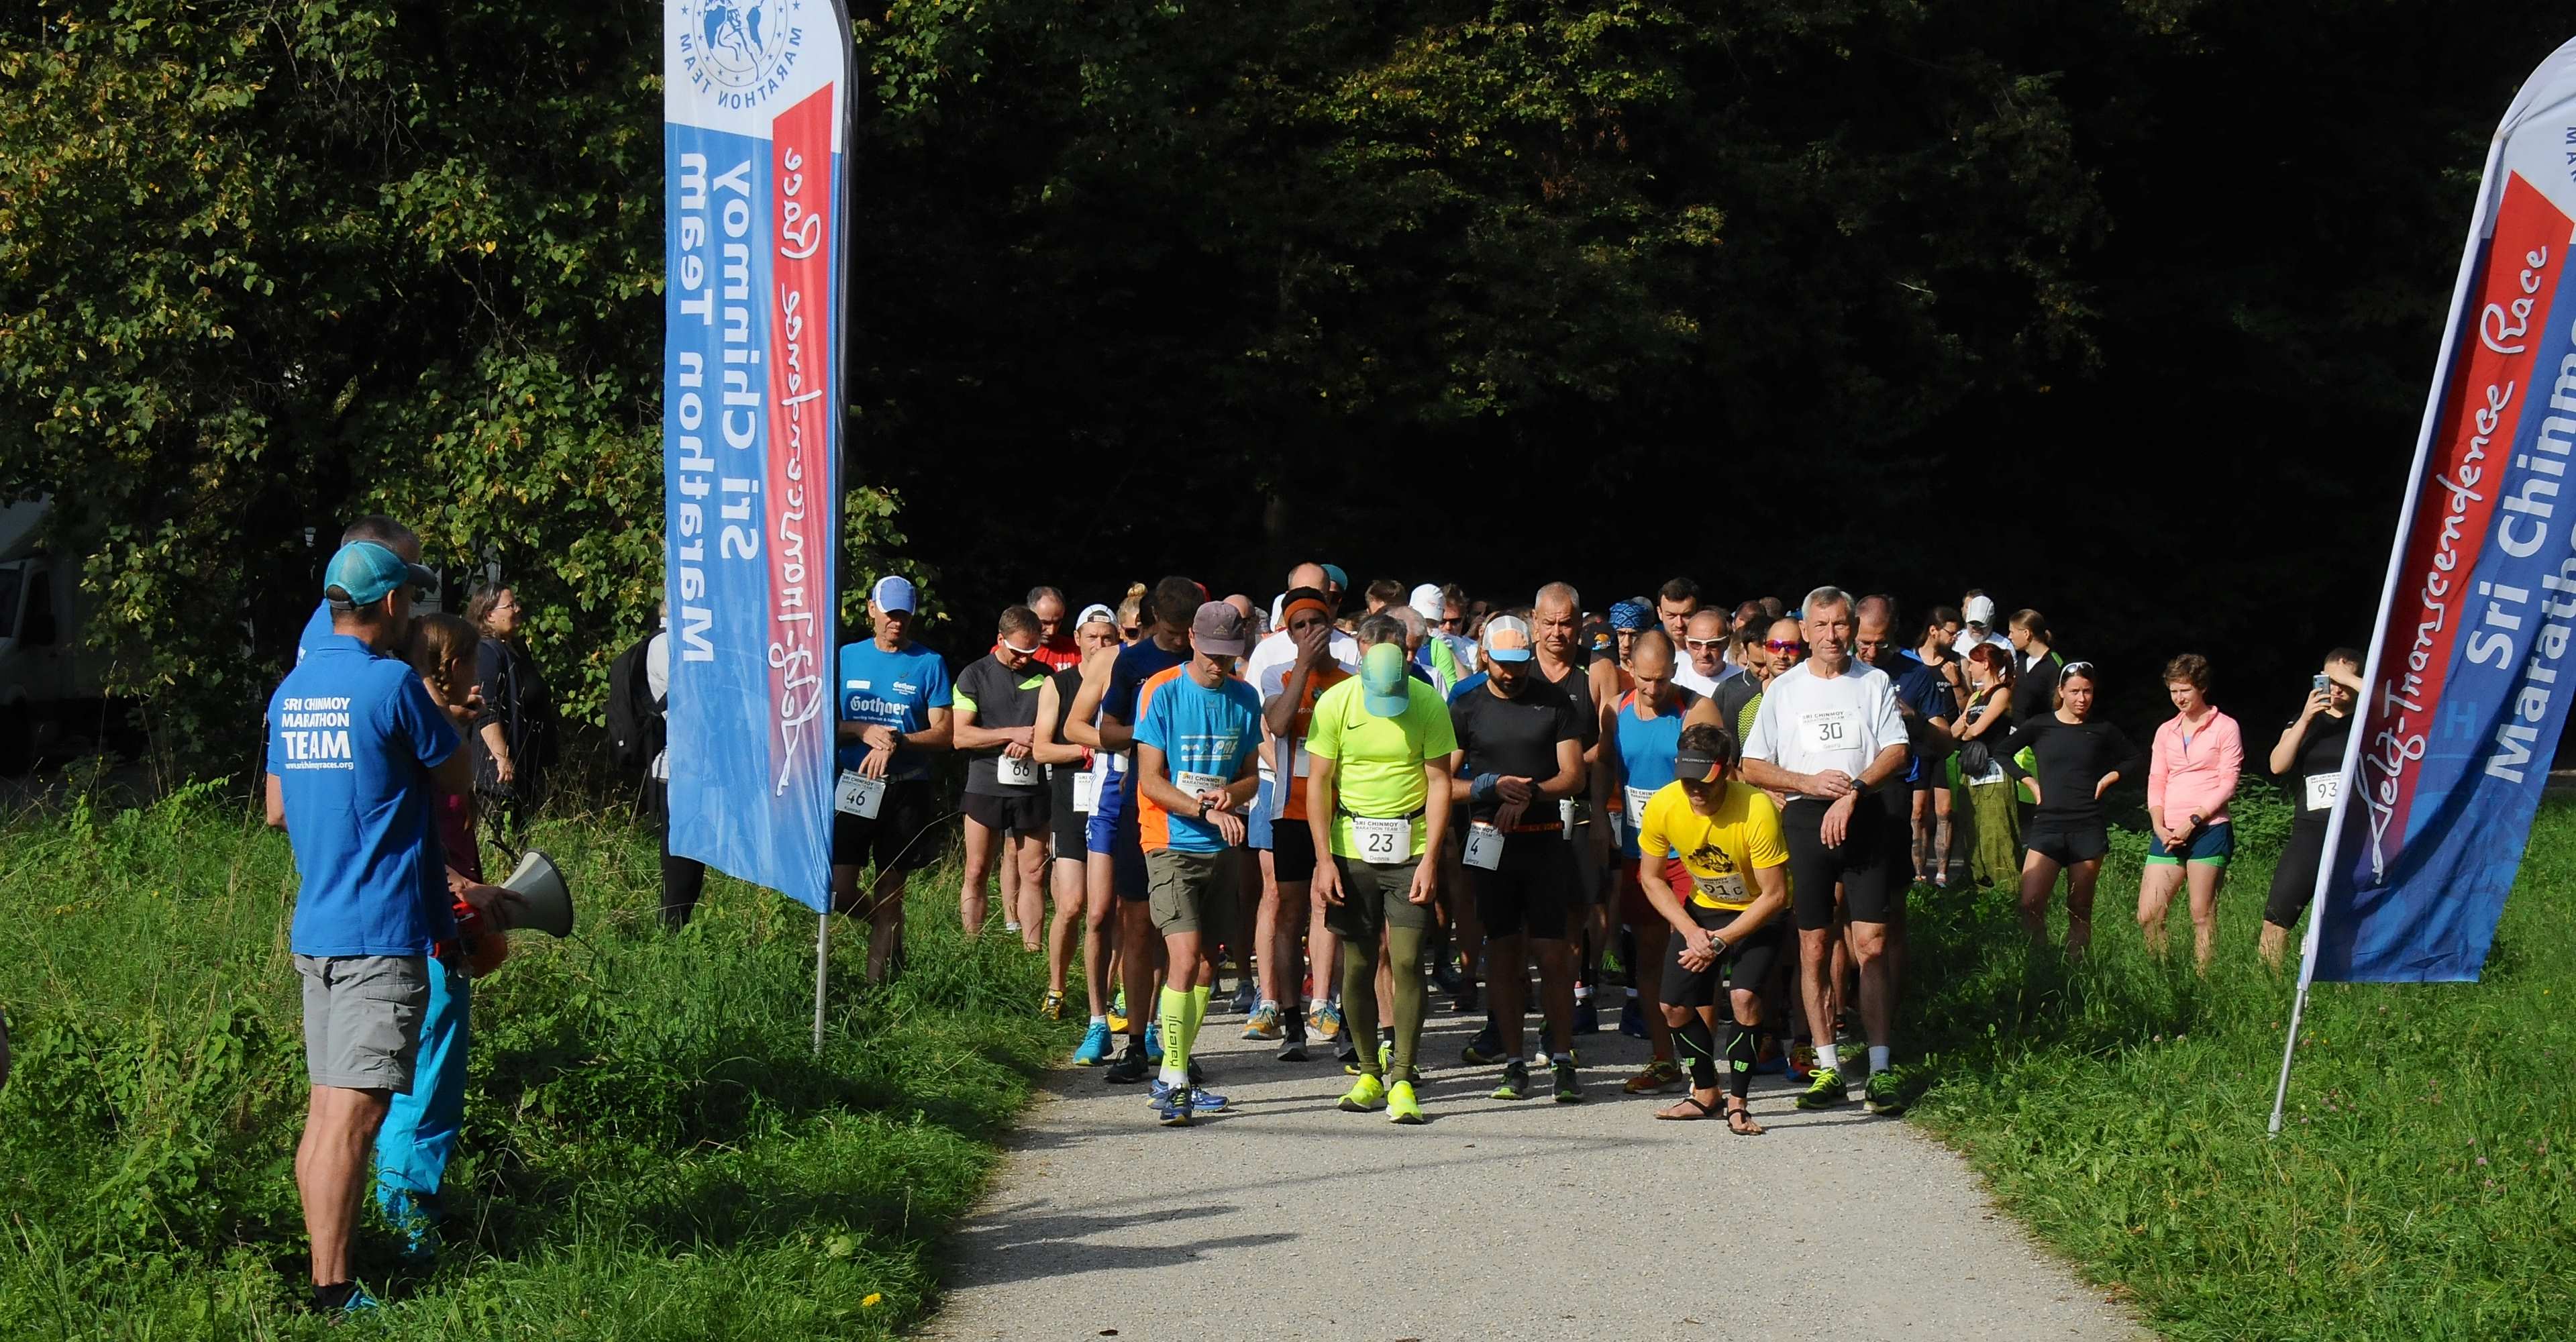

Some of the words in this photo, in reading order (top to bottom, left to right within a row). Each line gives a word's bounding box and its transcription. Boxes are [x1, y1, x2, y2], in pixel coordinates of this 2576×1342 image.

[2480, 246, 2548, 354] Race
[2466, 581, 2528, 670] Sri
[2497, 317, 2576, 558] Chinm
[2485, 521, 2576, 784] Marath
[283, 698, 301, 711] SRI
[304, 697, 351, 711] CHINMOY
[850, 695, 910, 716] Gothaer
[282, 713, 350, 728] MARATHON
[1818, 722, 1843, 741] 30
[281, 730, 352, 760] TEAM
[1013, 761, 1030, 777] 66
[846, 788, 866, 807] 46
[2318, 782, 2337, 798] 93
[1369, 833, 1393, 852] 23
[1470, 837, 1480, 856] 4
[1166, 1015, 1182, 1066] kalenji
